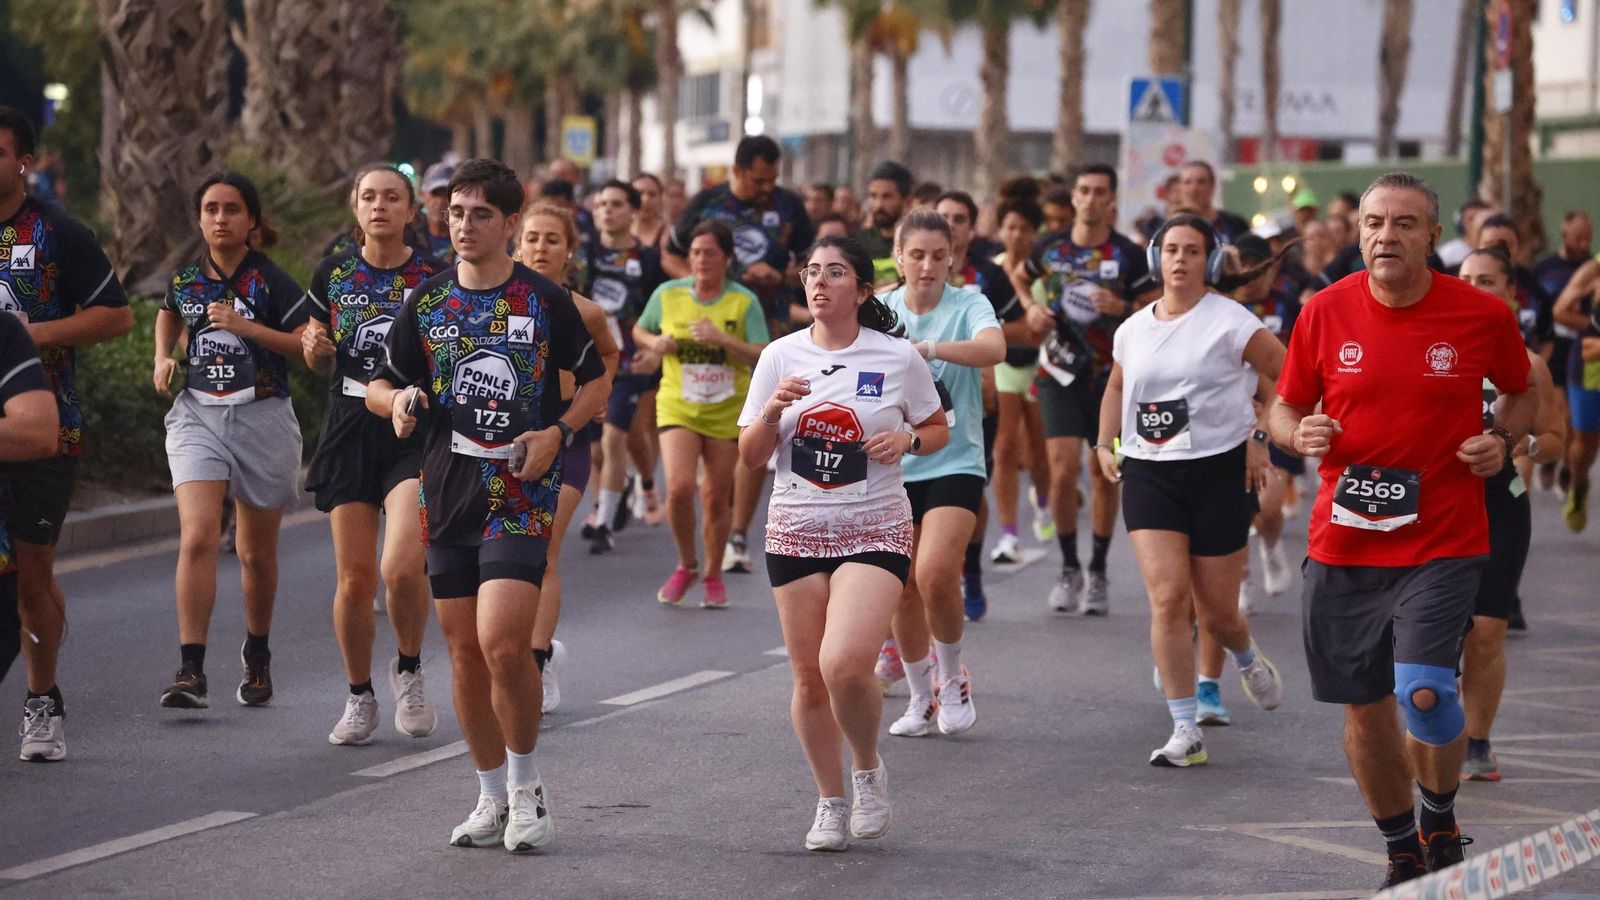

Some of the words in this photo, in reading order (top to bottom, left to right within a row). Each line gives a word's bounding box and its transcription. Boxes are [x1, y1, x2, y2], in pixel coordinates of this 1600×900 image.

[12, 257, 30, 267] AXA
[508, 329, 529, 341] AXA
[202, 337, 241, 354] PONLE
[1344, 348, 1358, 359] FIAT
[206, 365, 235, 379] 313
[463, 367, 511, 391] PONLE
[857, 384, 878, 395] AXA
[474, 408, 510, 427] 173
[1142, 411, 1174, 427] 690
[806, 418, 855, 440] PONLE
[815, 450, 843, 469] 117
[1345, 478, 1406, 500] 2569
